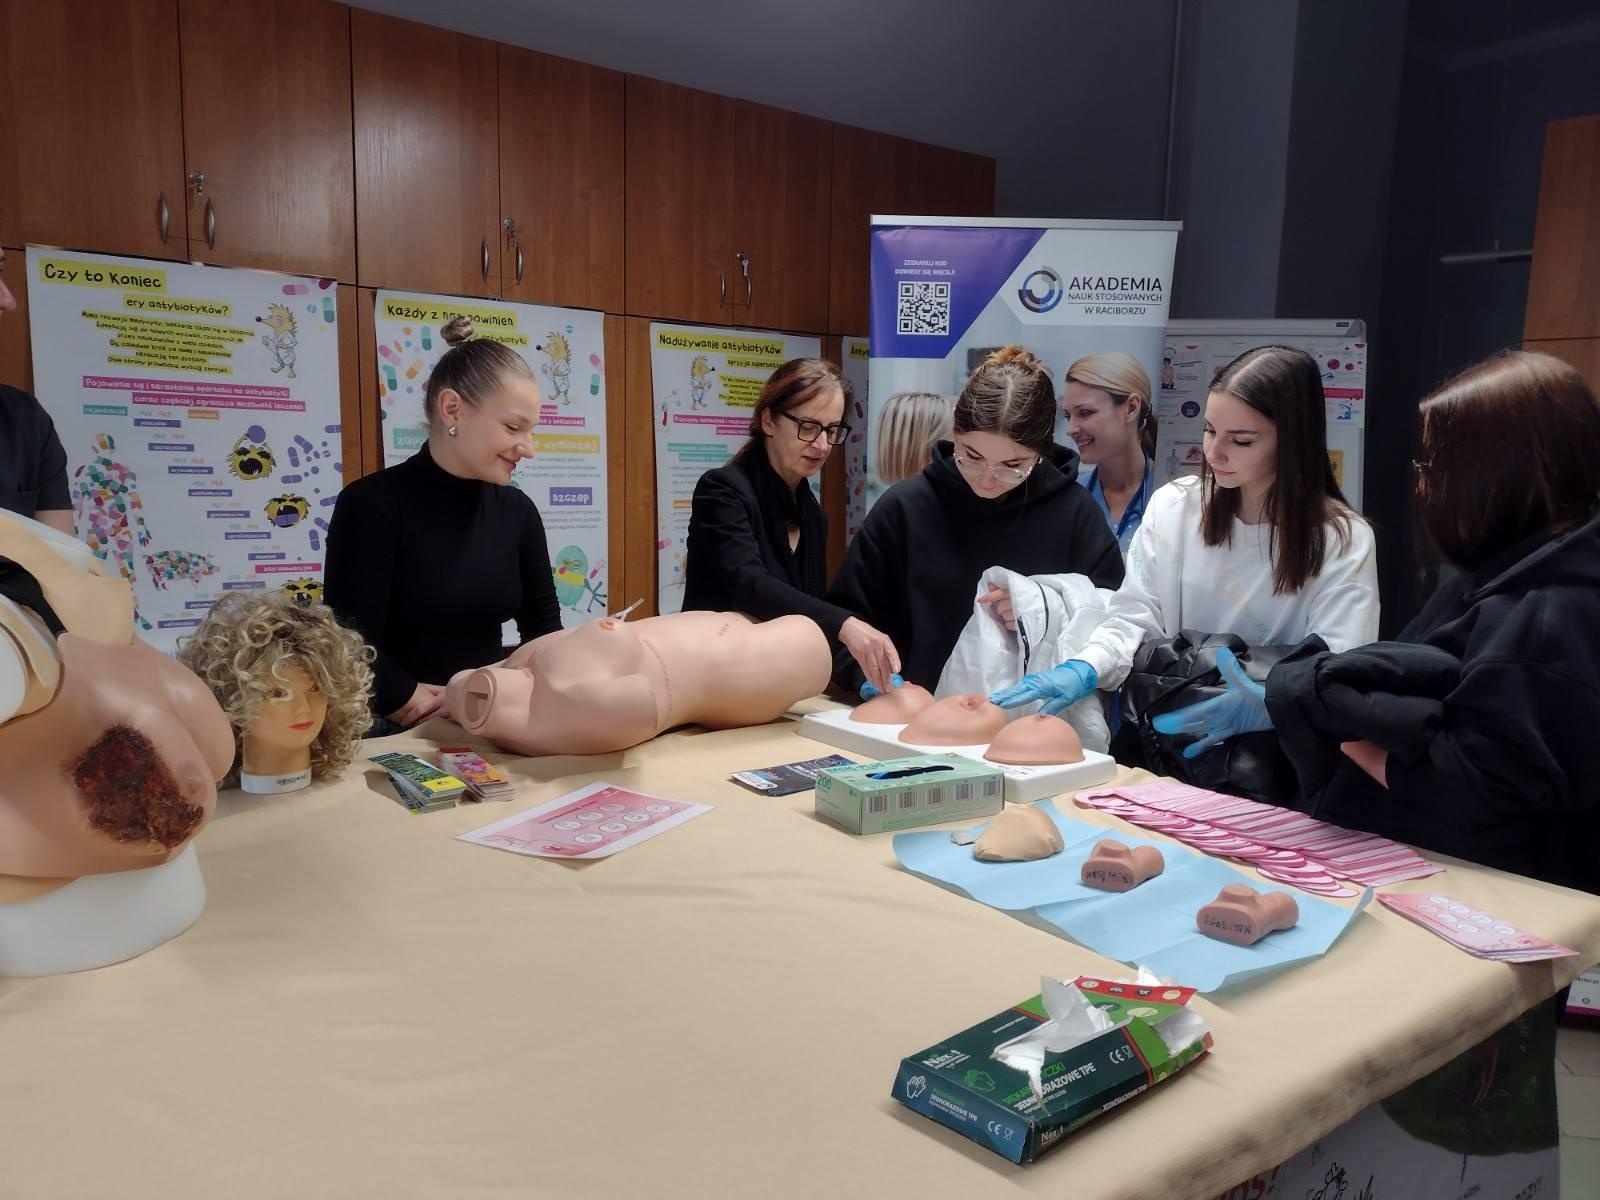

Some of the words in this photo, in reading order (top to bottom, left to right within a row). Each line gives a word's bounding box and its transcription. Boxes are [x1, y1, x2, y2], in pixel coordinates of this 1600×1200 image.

[45, 263, 78, 282] Czy
[84, 269, 103, 283] to
[1069, 276, 1162, 292] AKADEMIA
[1068, 292, 1094, 301] NAUK
[1095, 293, 1163, 303] STOSOWANYCH
[127, 298, 145, 308] ery
[149, 299, 228, 316] antybiotyków?
[387, 304, 428, 320] Każdy
[431, 311, 440, 320] z
[1084, 306, 1094, 315] W
[1095, 306, 1146, 315] RACIBORZU
[659, 333, 719, 350] Nadużywanie
[721, 342, 781, 355] antybiotyków
[553, 493, 589, 504] szczep
[817, 774, 832, 791] 200
[1081, 1062, 1097, 1076] TPE
